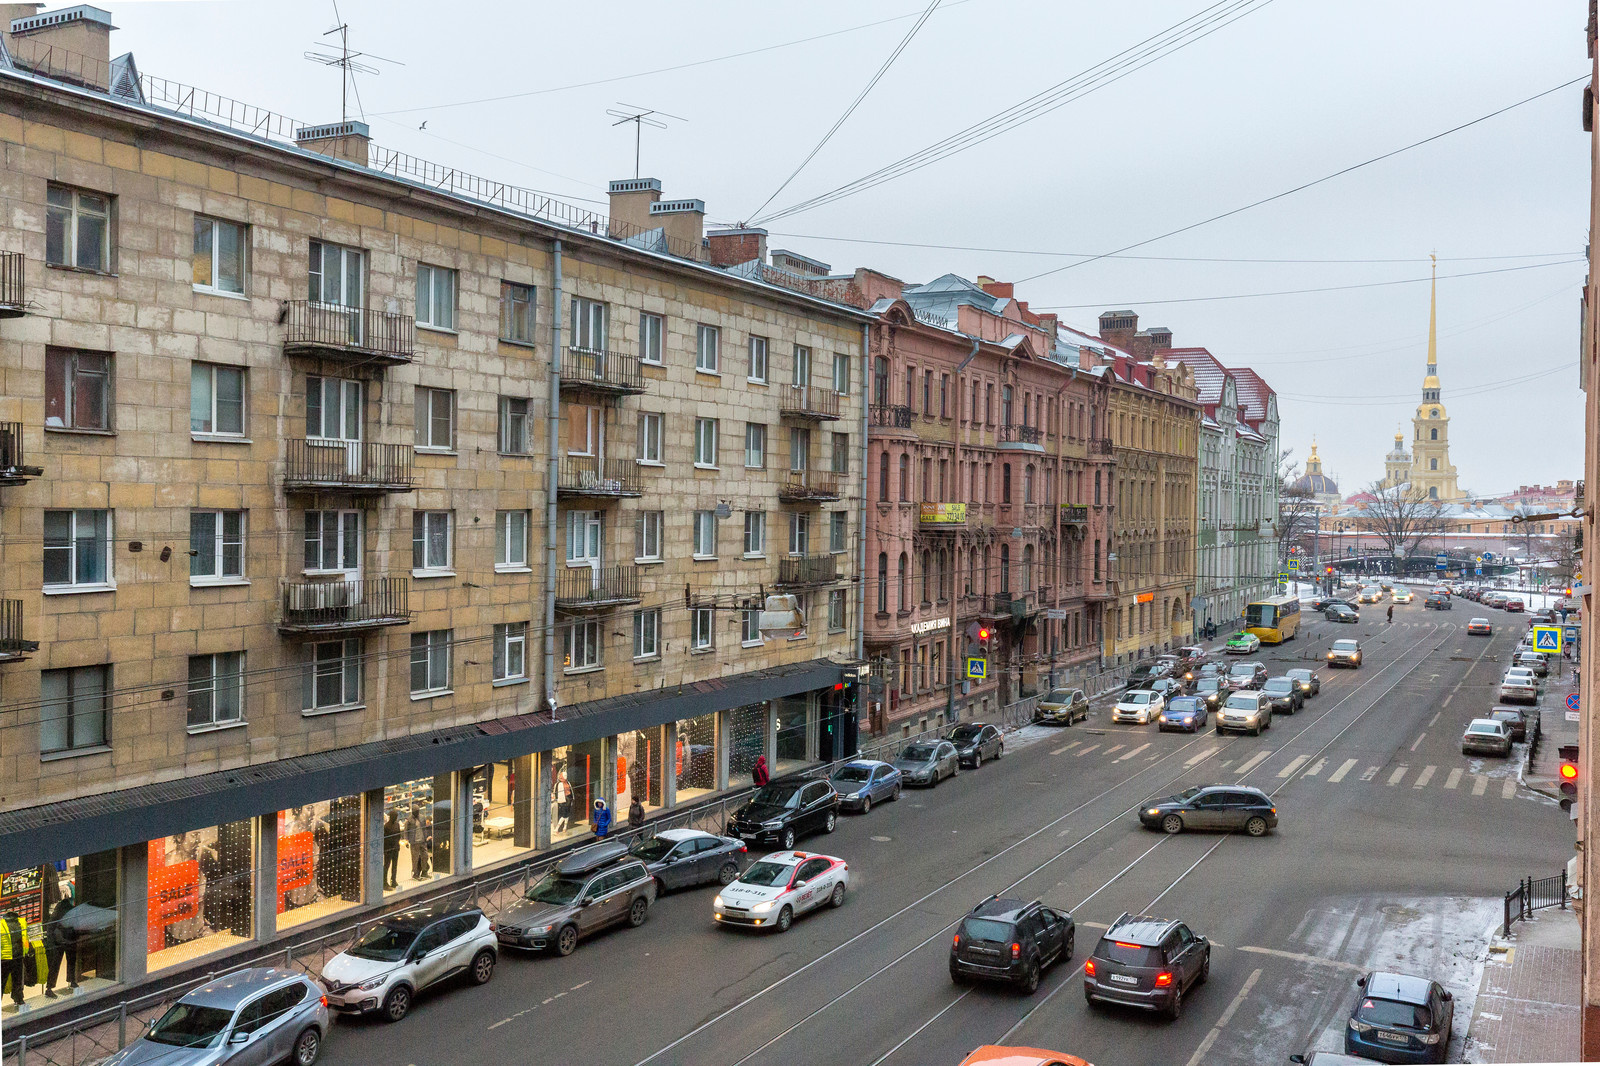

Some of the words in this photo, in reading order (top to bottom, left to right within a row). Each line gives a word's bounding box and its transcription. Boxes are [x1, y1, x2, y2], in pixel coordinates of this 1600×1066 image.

[281, 852, 308, 871] SALE
[160, 883, 193, 903] SALE
[729, 888, 767, 897] 318-0-318
